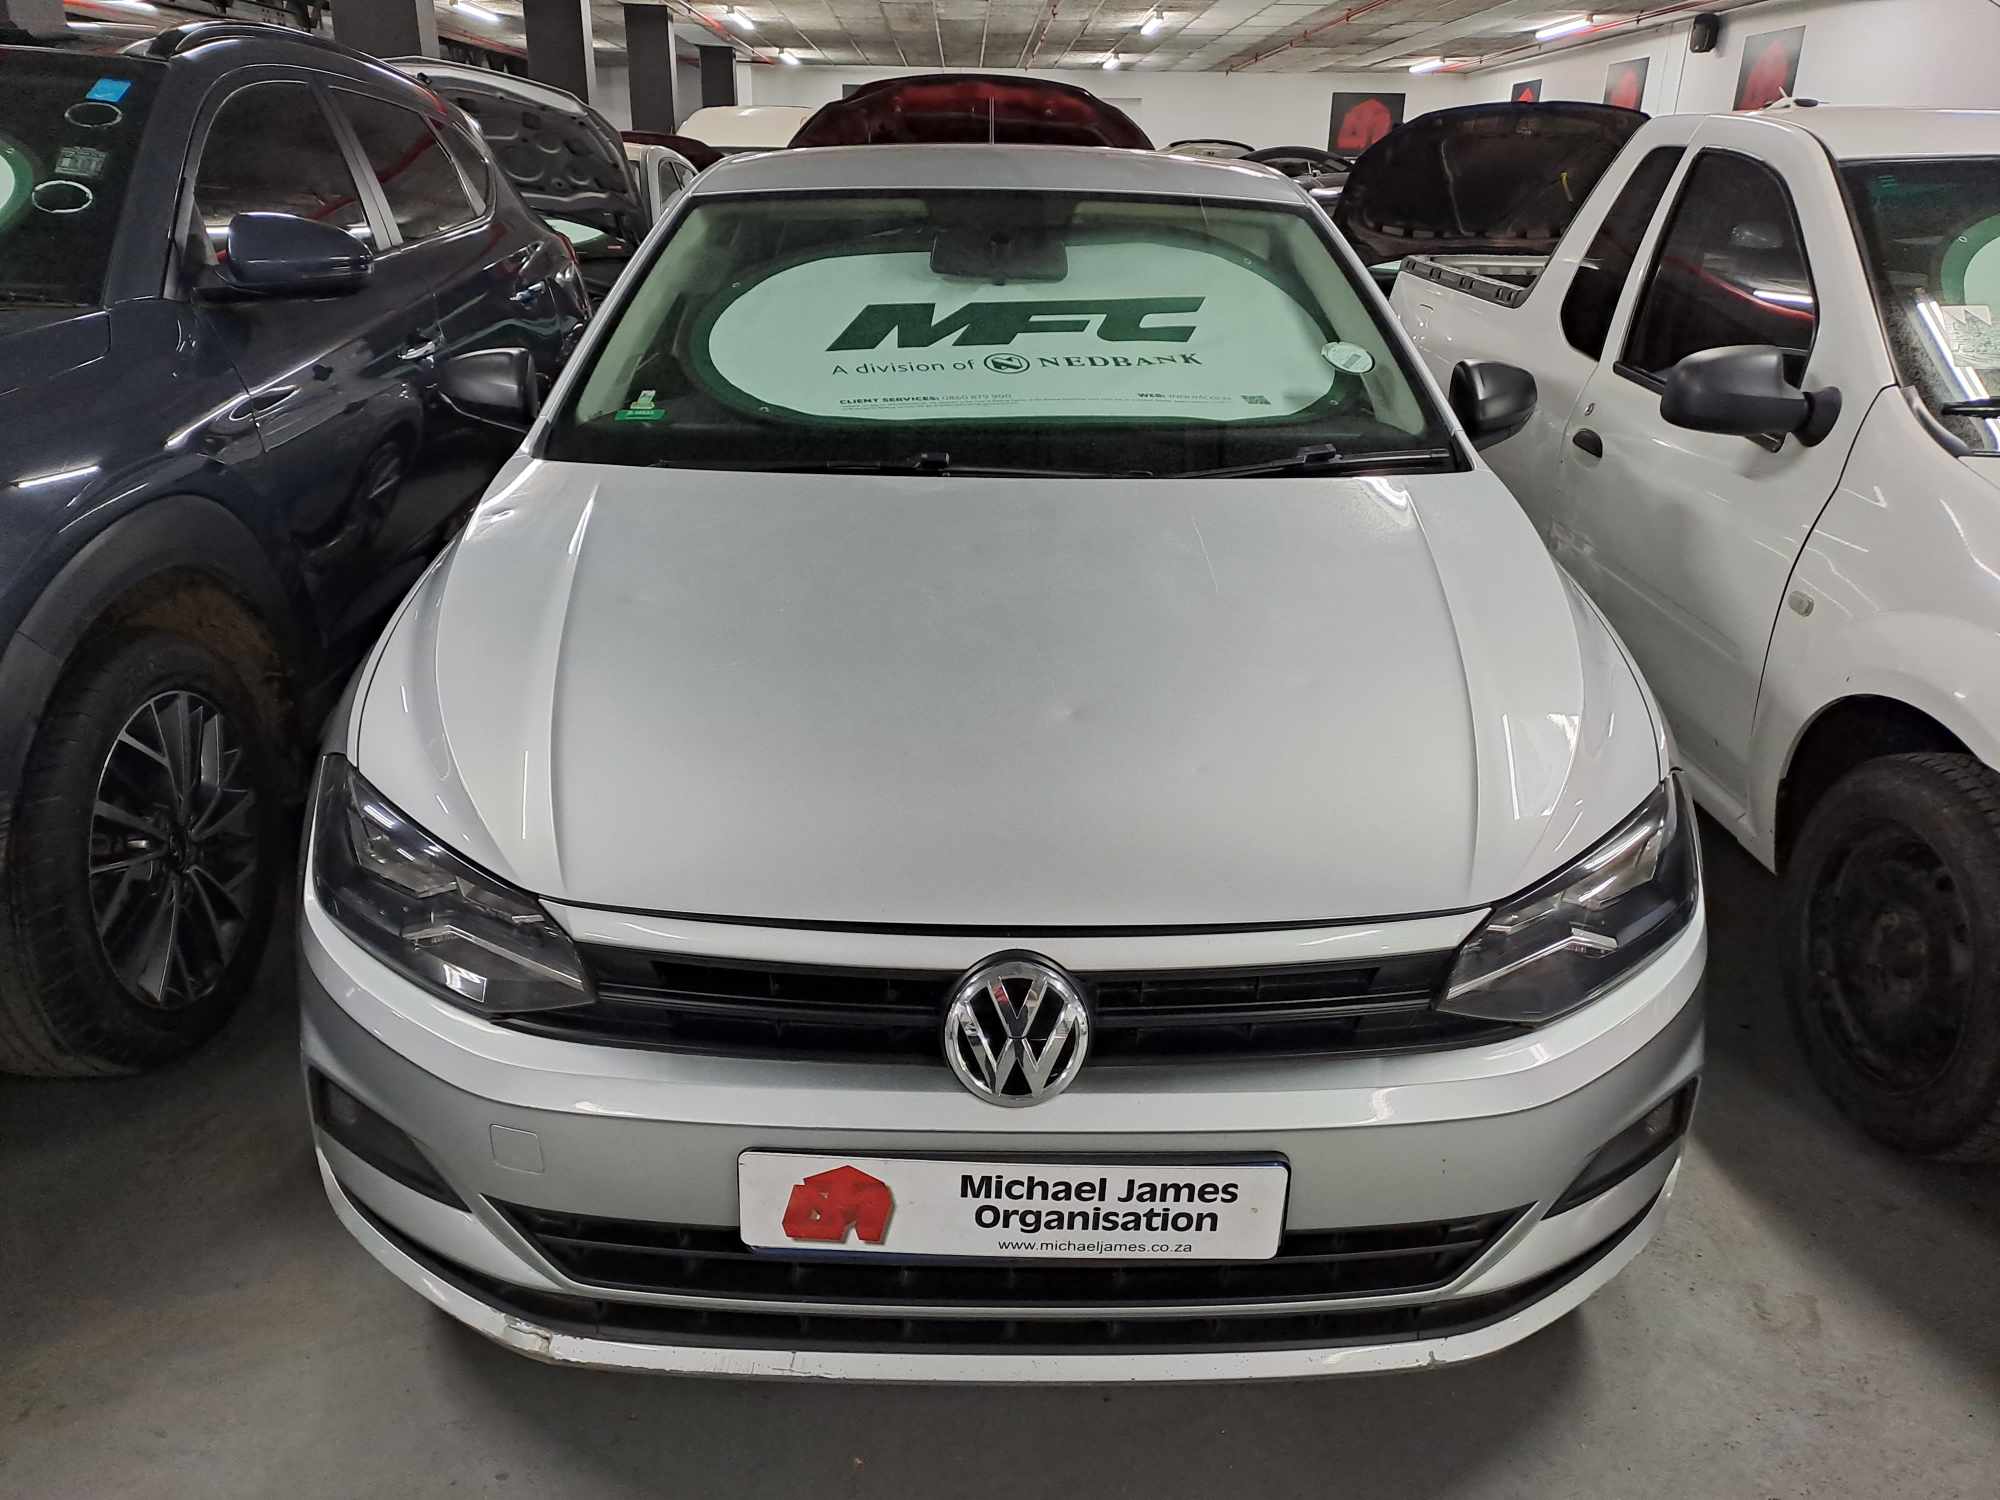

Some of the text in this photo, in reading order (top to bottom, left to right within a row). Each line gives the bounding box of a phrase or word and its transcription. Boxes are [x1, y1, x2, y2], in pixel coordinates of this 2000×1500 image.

[825, 296, 1206, 352] MFC
[832, 364, 849, 376] A
[855, 361, 945, 375] division
[952, 358, 975, 371] of
[1036, 352, 1203, 368] NEDBANK
[960, 1174, 1239, 1203] Michael James
[974, 1204, 1219, 1234] Organisation
[998, 1240, 1192, 1254] www.michaeljames.co.za
